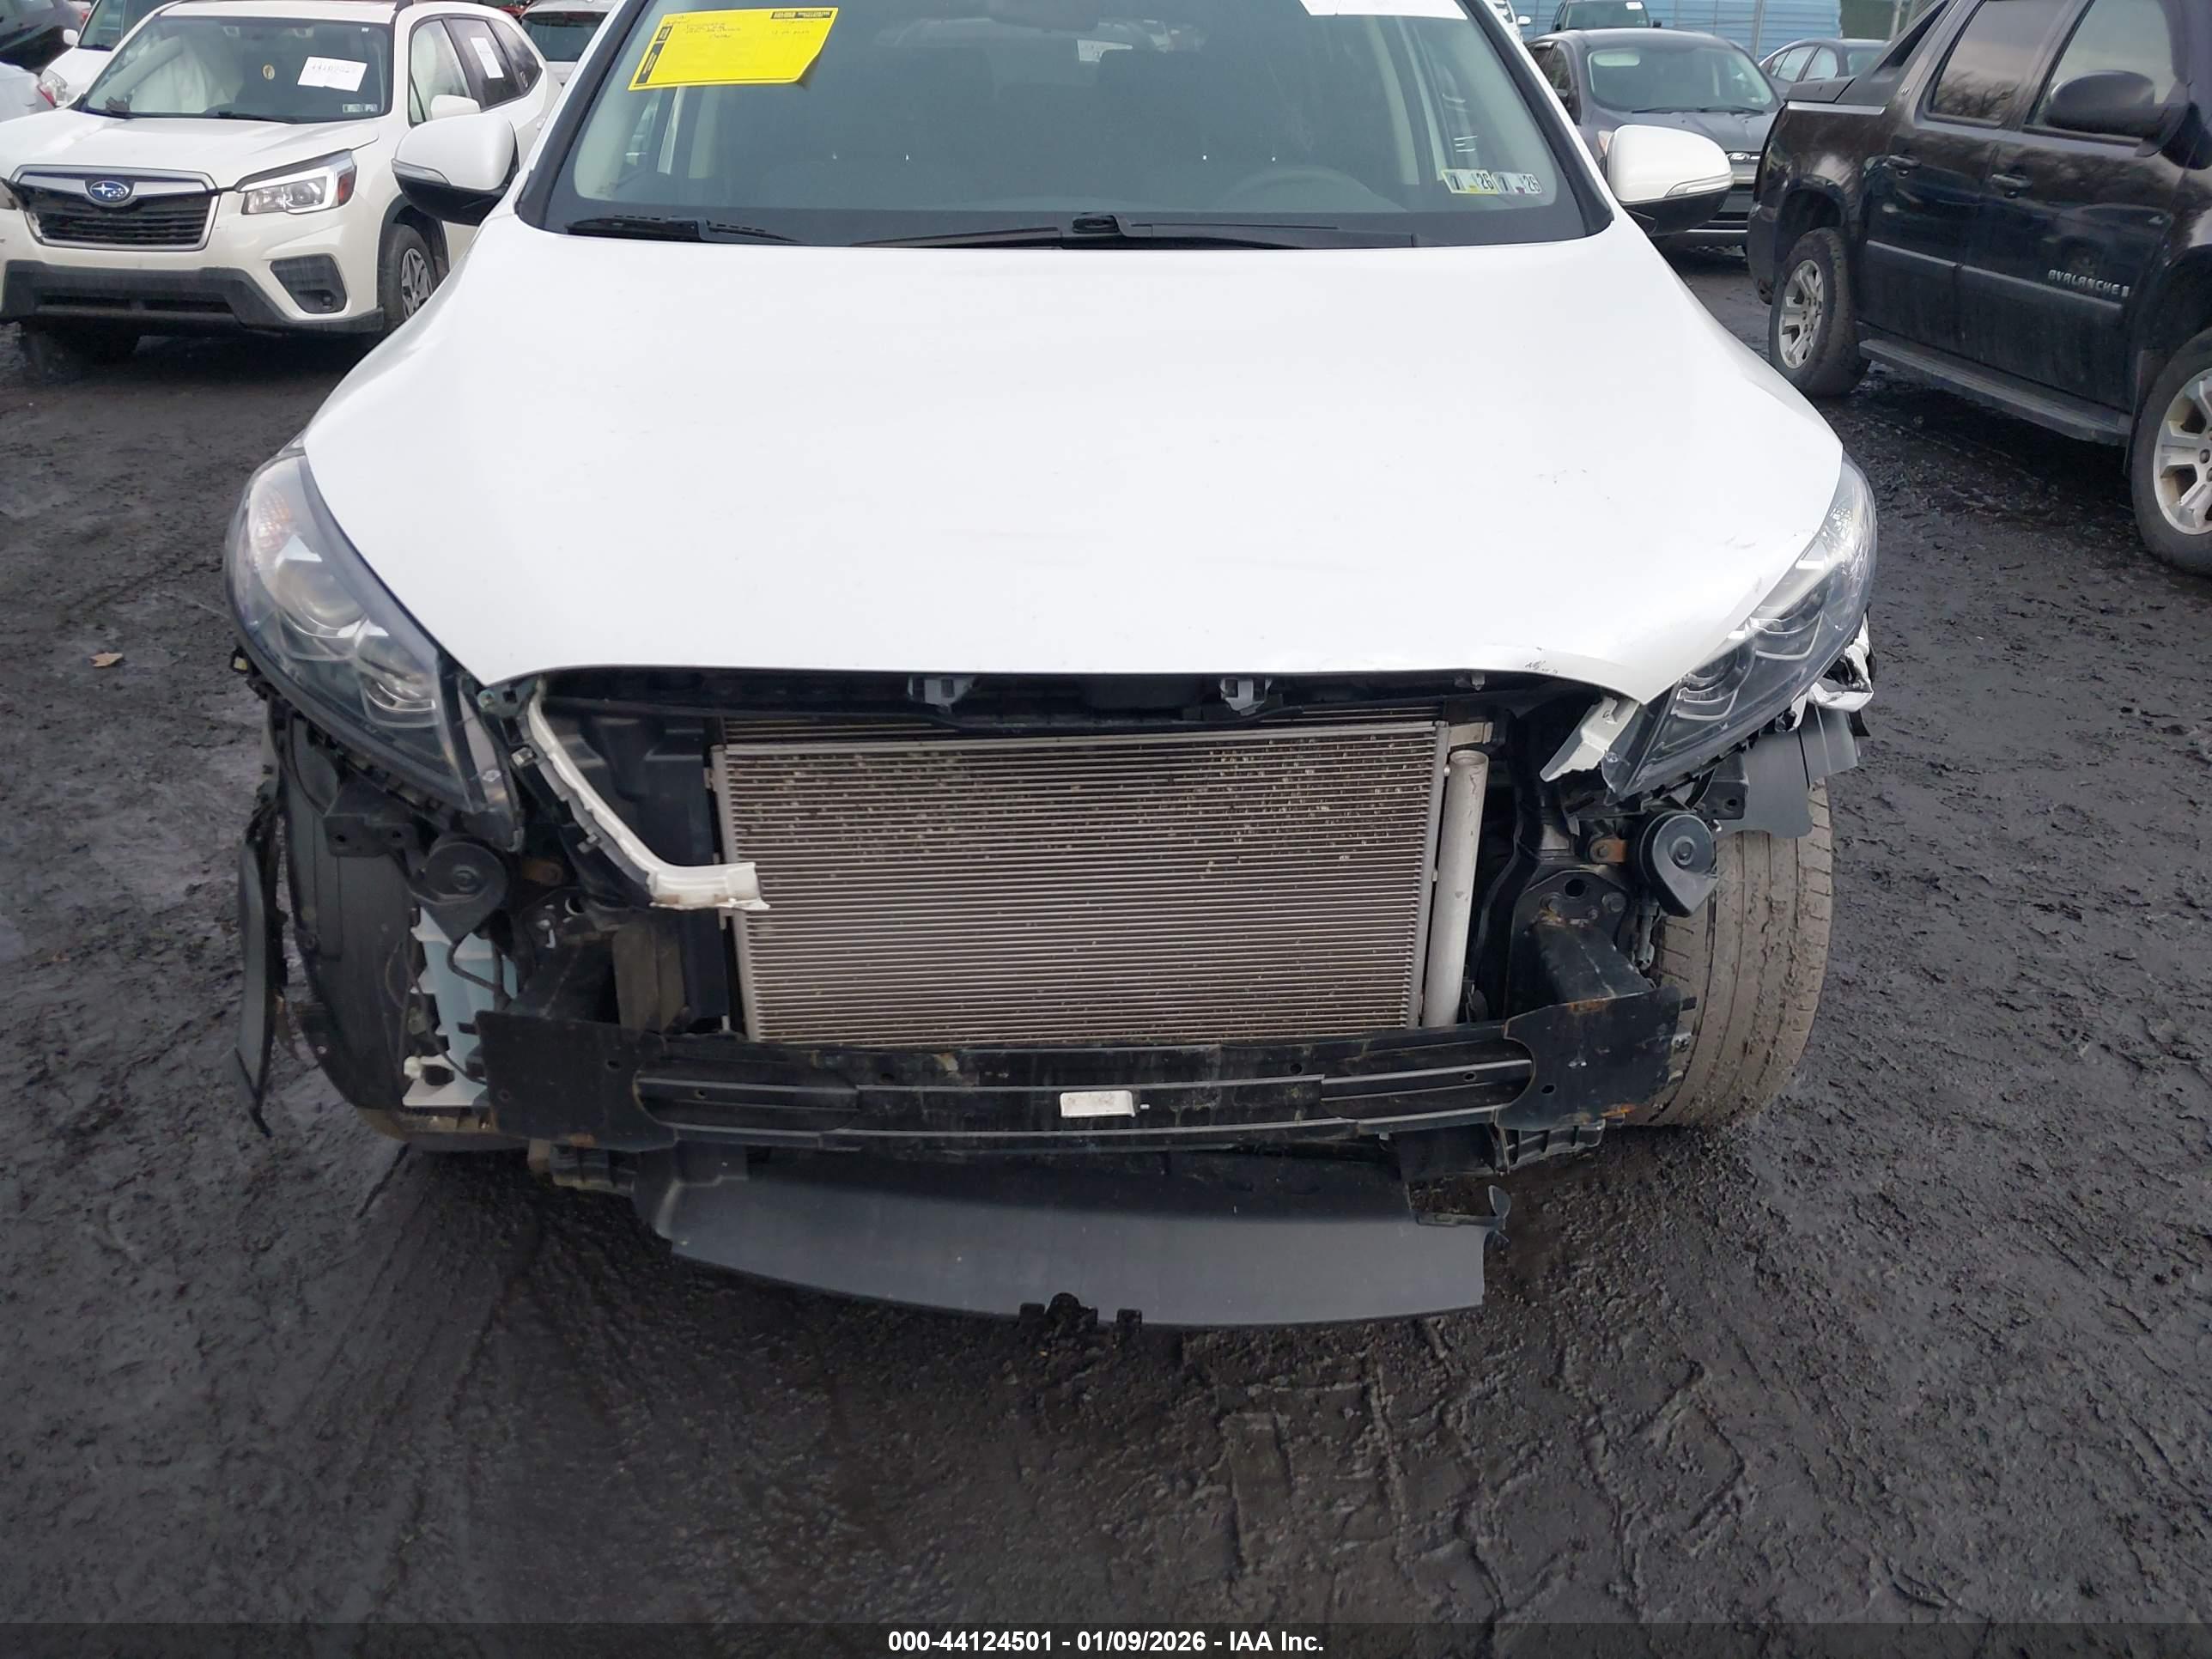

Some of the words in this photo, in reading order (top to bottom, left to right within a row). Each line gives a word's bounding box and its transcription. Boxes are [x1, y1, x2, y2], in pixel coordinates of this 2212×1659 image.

[1476, 173, 1494, 191] 26
[1522, 174, 1541, 192] 26
[2047, 269, 2121, 295] AVALANCHE
